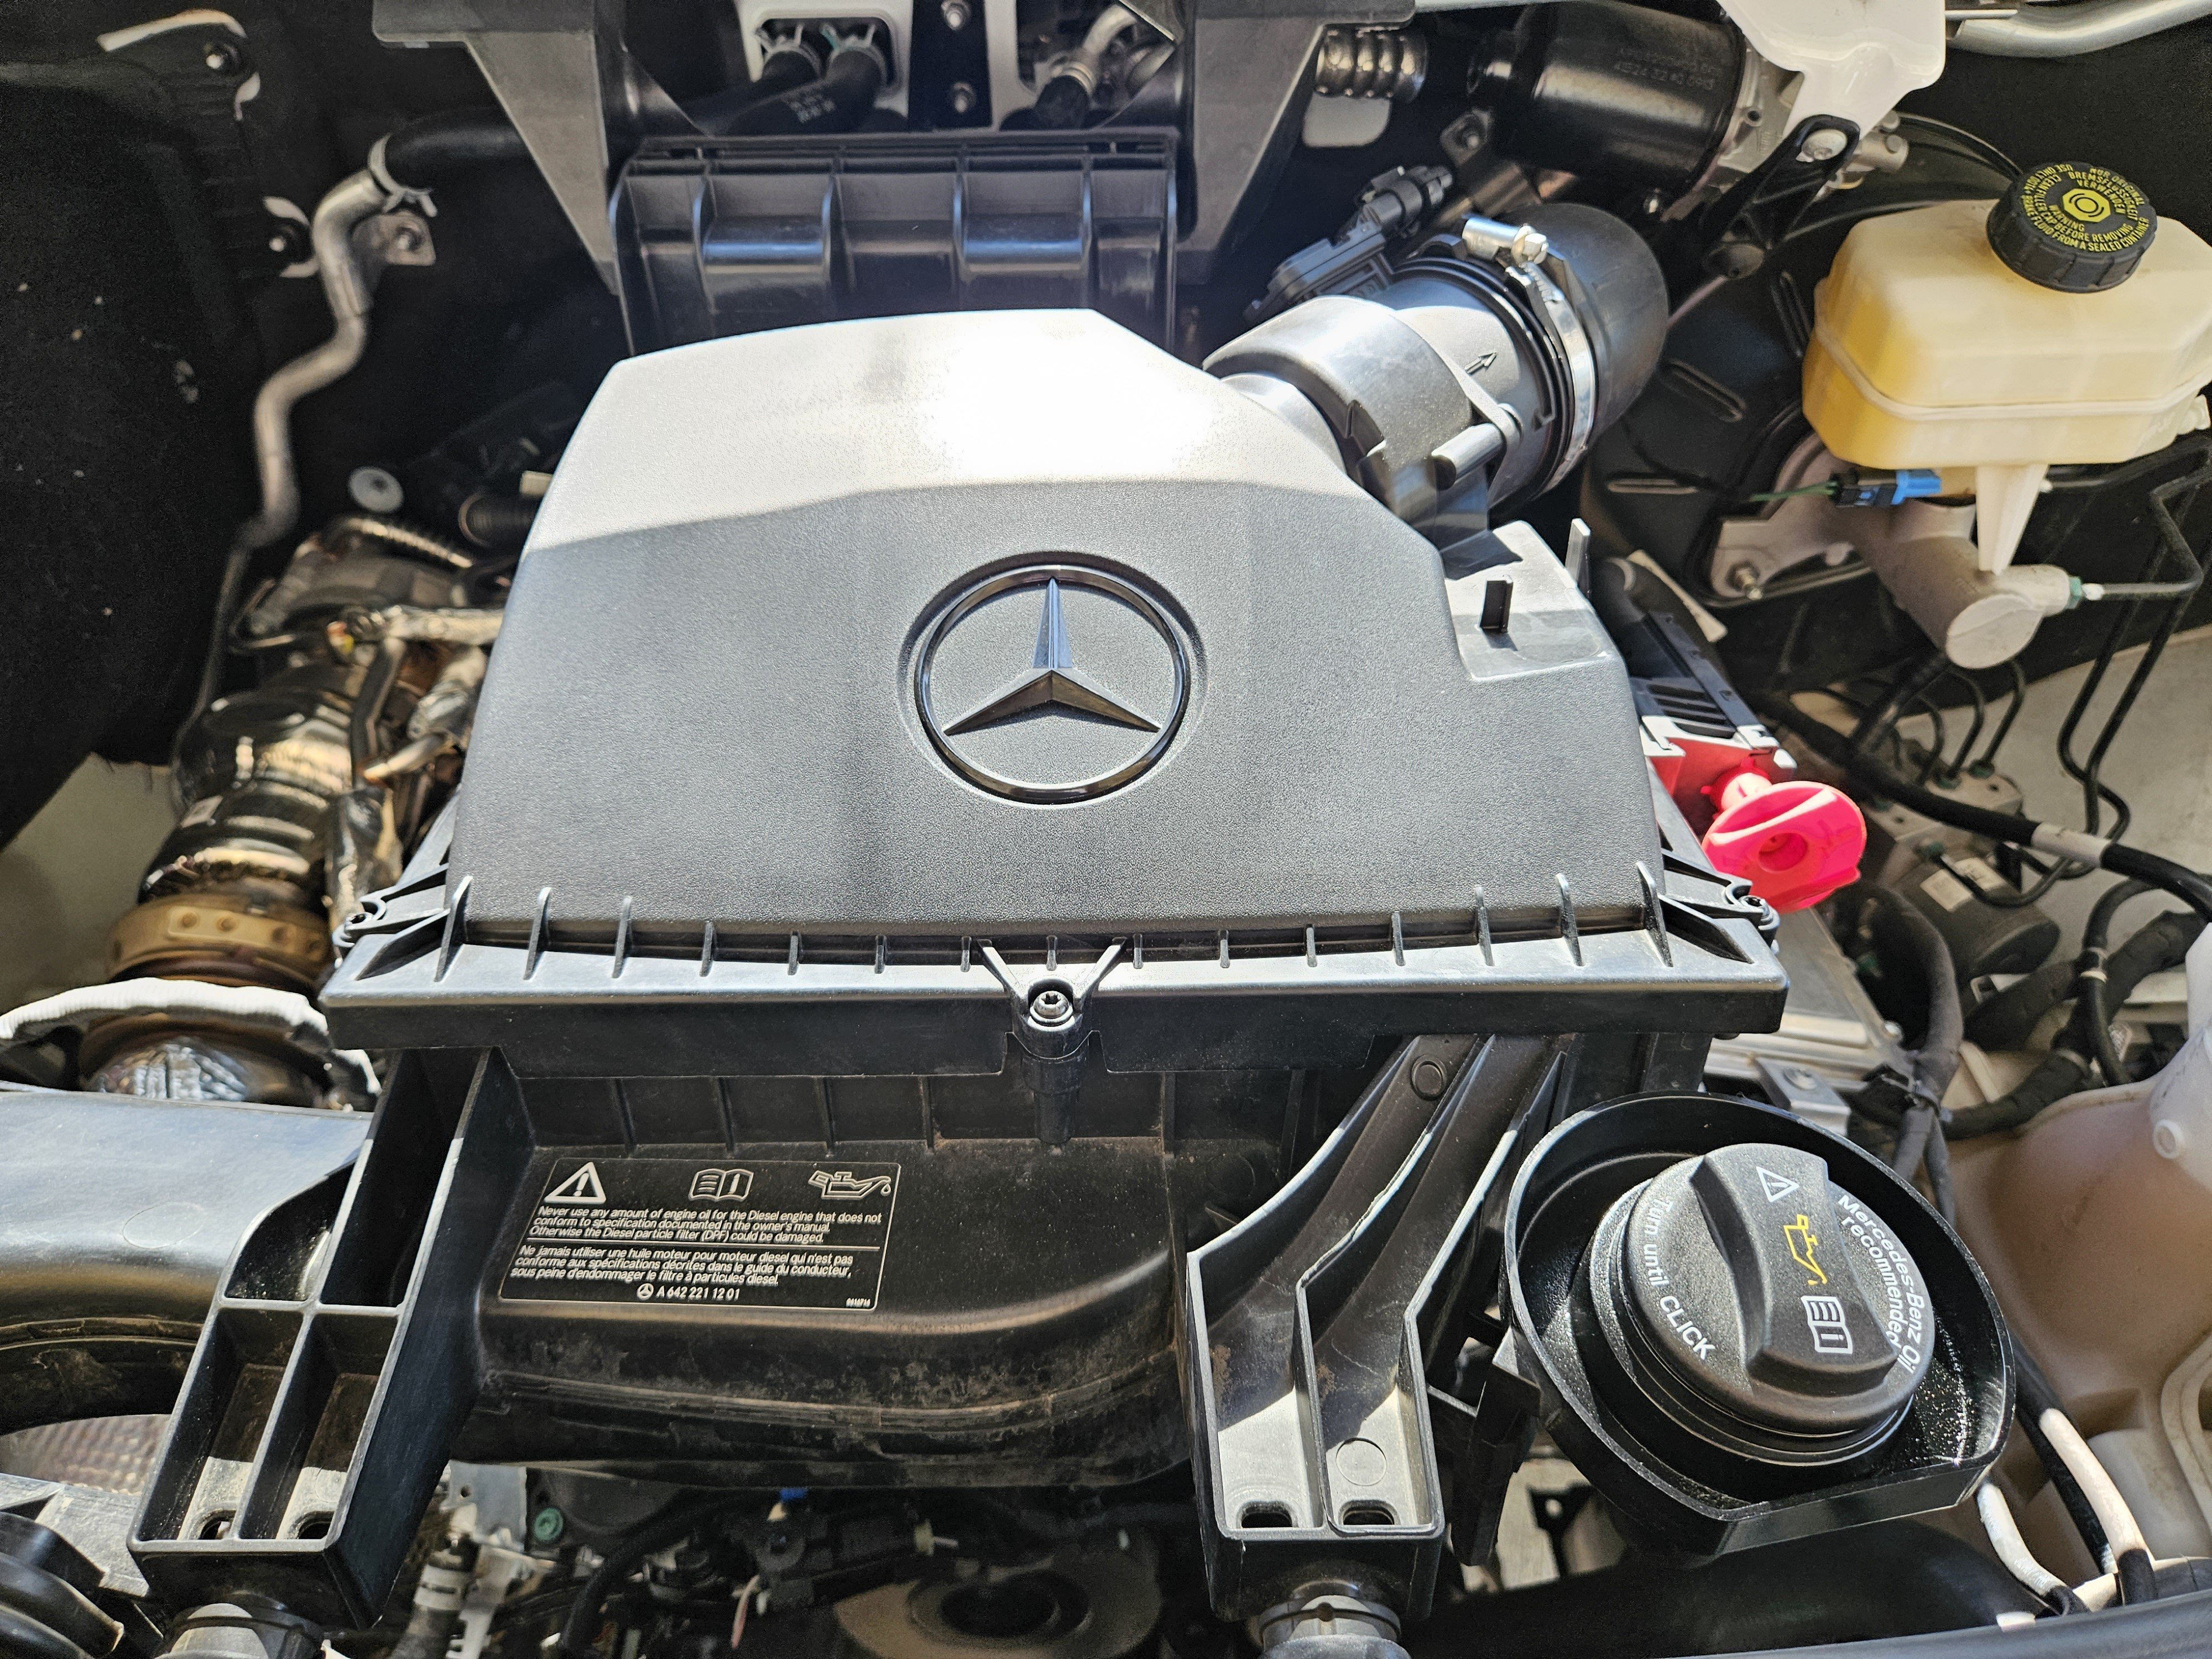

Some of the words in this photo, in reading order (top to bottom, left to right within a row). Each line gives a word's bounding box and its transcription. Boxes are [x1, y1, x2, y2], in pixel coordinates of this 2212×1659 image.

[2077, 179, 2126, 215] VERWENDEN
[2040, 211, 2058, 224] CAP
[2054, 222, 2090, 242] BEFORE
[2091, 223, 2134, 243] REMOVING
[2048, 204, 2085, 232] WARNING
[2030, 215, 2054, 235] FLUID
[2052, 231, 2078, 248] FROM
[2079, 242, 2086, 250] A
[2088, 240, 2122, 252] SEALED
[2120, 216, 2150, 248] CONTAINER
[534, 1216, 578, 1226] conform
[579, 1217, 591, 1226] to
[592, 1218, 657, 1228] specification
[658, 1219, 722, 1230] documented
[723, 1220, 732, 1230] in
[733, 1220, 750, 1230] the
[753, 1222, 792, 1232] owner's
[538, 1206, 570, 1216] Never
[570, 1208, 589, 1217] use
[611, 1208, 649, 1218] amount
[650, 1208, 663, 1219] of
[664, 1209, 697, 1220] engine
[698, 1209, 711, 1219] oil
[712, 1209, 728, 1220] for
[729, 1210, 747, 1220] the
[748, 1210, 779, 1222] Diesel
[780, 1211, 813, 1223] engine
[816, 1212, 836, 1222] that
[837, 1212, 863, 1223] does
[864, 1213, 882, 1224] not
[1644, 1198, 1673, 1236] Turn
[529, 1225, 583, 1237] Otherwise
[584, 1227, 602, 1237] the
[601, 1227, 635, 1238] Diesel
[633, 1229, 674, 1239] particle
[675, 1229, 700, 1240] filter
[701, 1229, 729, 1242] (DPF)
[731, 1231, 759, 1242] could
[759, 1232, 773, 1242] be
[774, 1232, 824, 1244] damaged.
[514, 1256, 567, 1267] conforme
[567, 1259, 587, 1267] aux
[588, 1258, 661, 1270] spécifications
[662, 1260, 706, 1271] décrites
[707, 1262, 732, 1272] dans
[733, 1262, 743, 1272] le
[744, 1263, 774, 1275] guide
[775, 1264, 790, 1275] du
[519, 1245, 536, 1255] Ne
[535, 1245, 571, 1257] jamais
[572, 1246, 607, 1257] utiliser
[608, 1249, 627, 1258] une
[627, 1248, 652, 1259] huile
[653, 1249, 691, 1260] moteur
[691, 1251, 717, 1262] pour
[718, 1251, 757, 1262] moteur
[758, 1252, 790, 1264] diesel
[790, 1253, 806, 1265] qui
[806, 1253, 832, 1265] n'est
[833, 1255, 853, 1267] pas
[1643, 1244, 1670, 1287] until
[510, 1267, 536, 1278] sous
[535, 1267, 566, 1280] peine
[567, 1267, 646, 1283] d'endommager
[646, 1270, 656, 1281] le
[658, 1270, 684, 1281] filtre
[685, 1271, 692, 1281] à
[692, 1273, 745, 1285] particules
[1838, 1194, 1925, 1344] Mercedes-Benz
[1897, 1344, 1921, 1374] Oil
[1841, 1216, 1909, 1349] recommended
[656, 1286, 665, 1298] A
[666, 1286, 687, 1298] 642
[688, 1286, 709, 1299] 221
[712, 1287, 725, 1300] 12
[726, 1288, 740, 1301] 01
[1660, 1295, 1715, 1360] CLICK
